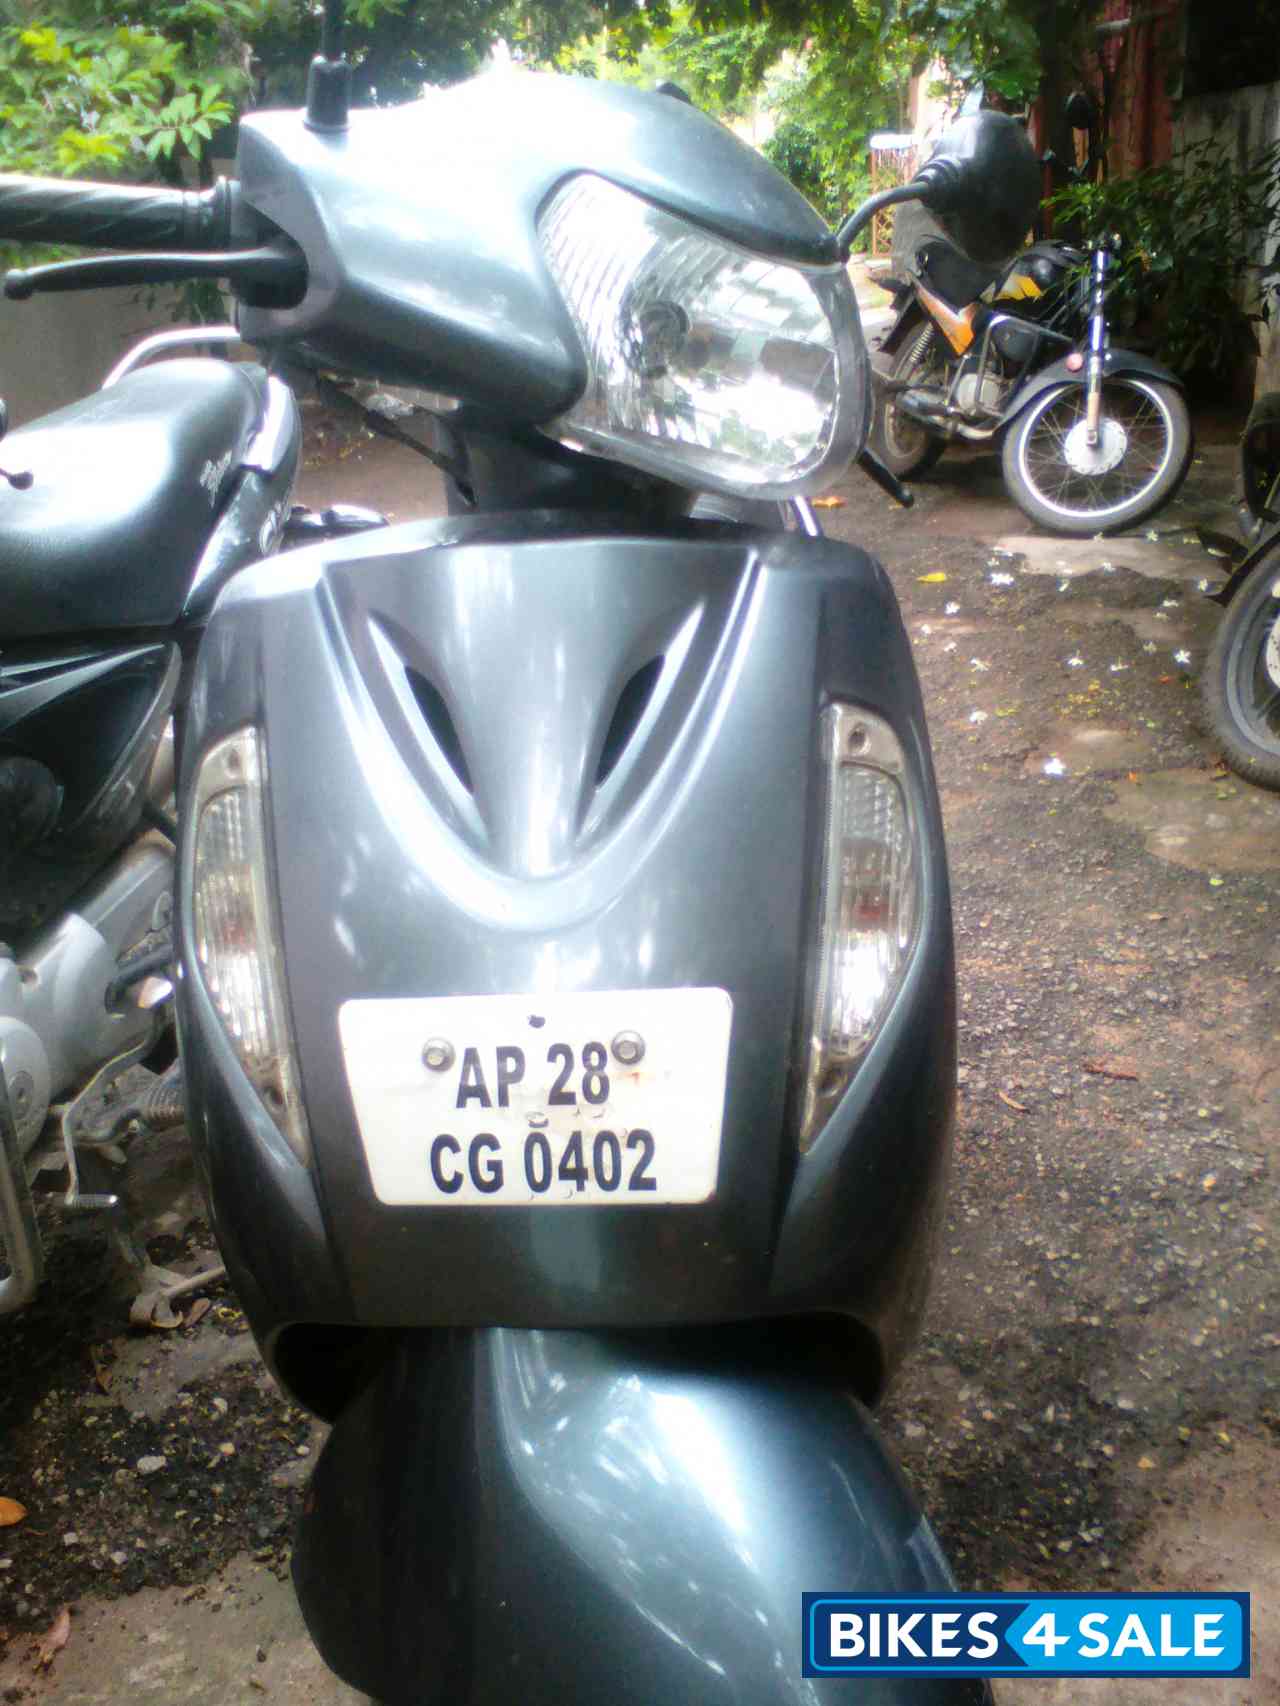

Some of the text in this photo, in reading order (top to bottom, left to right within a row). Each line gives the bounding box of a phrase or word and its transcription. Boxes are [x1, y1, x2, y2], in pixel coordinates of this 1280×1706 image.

[455, 1041, 611, 1109] AP 28
[430, 1128, 658, 1194] CG 0402
